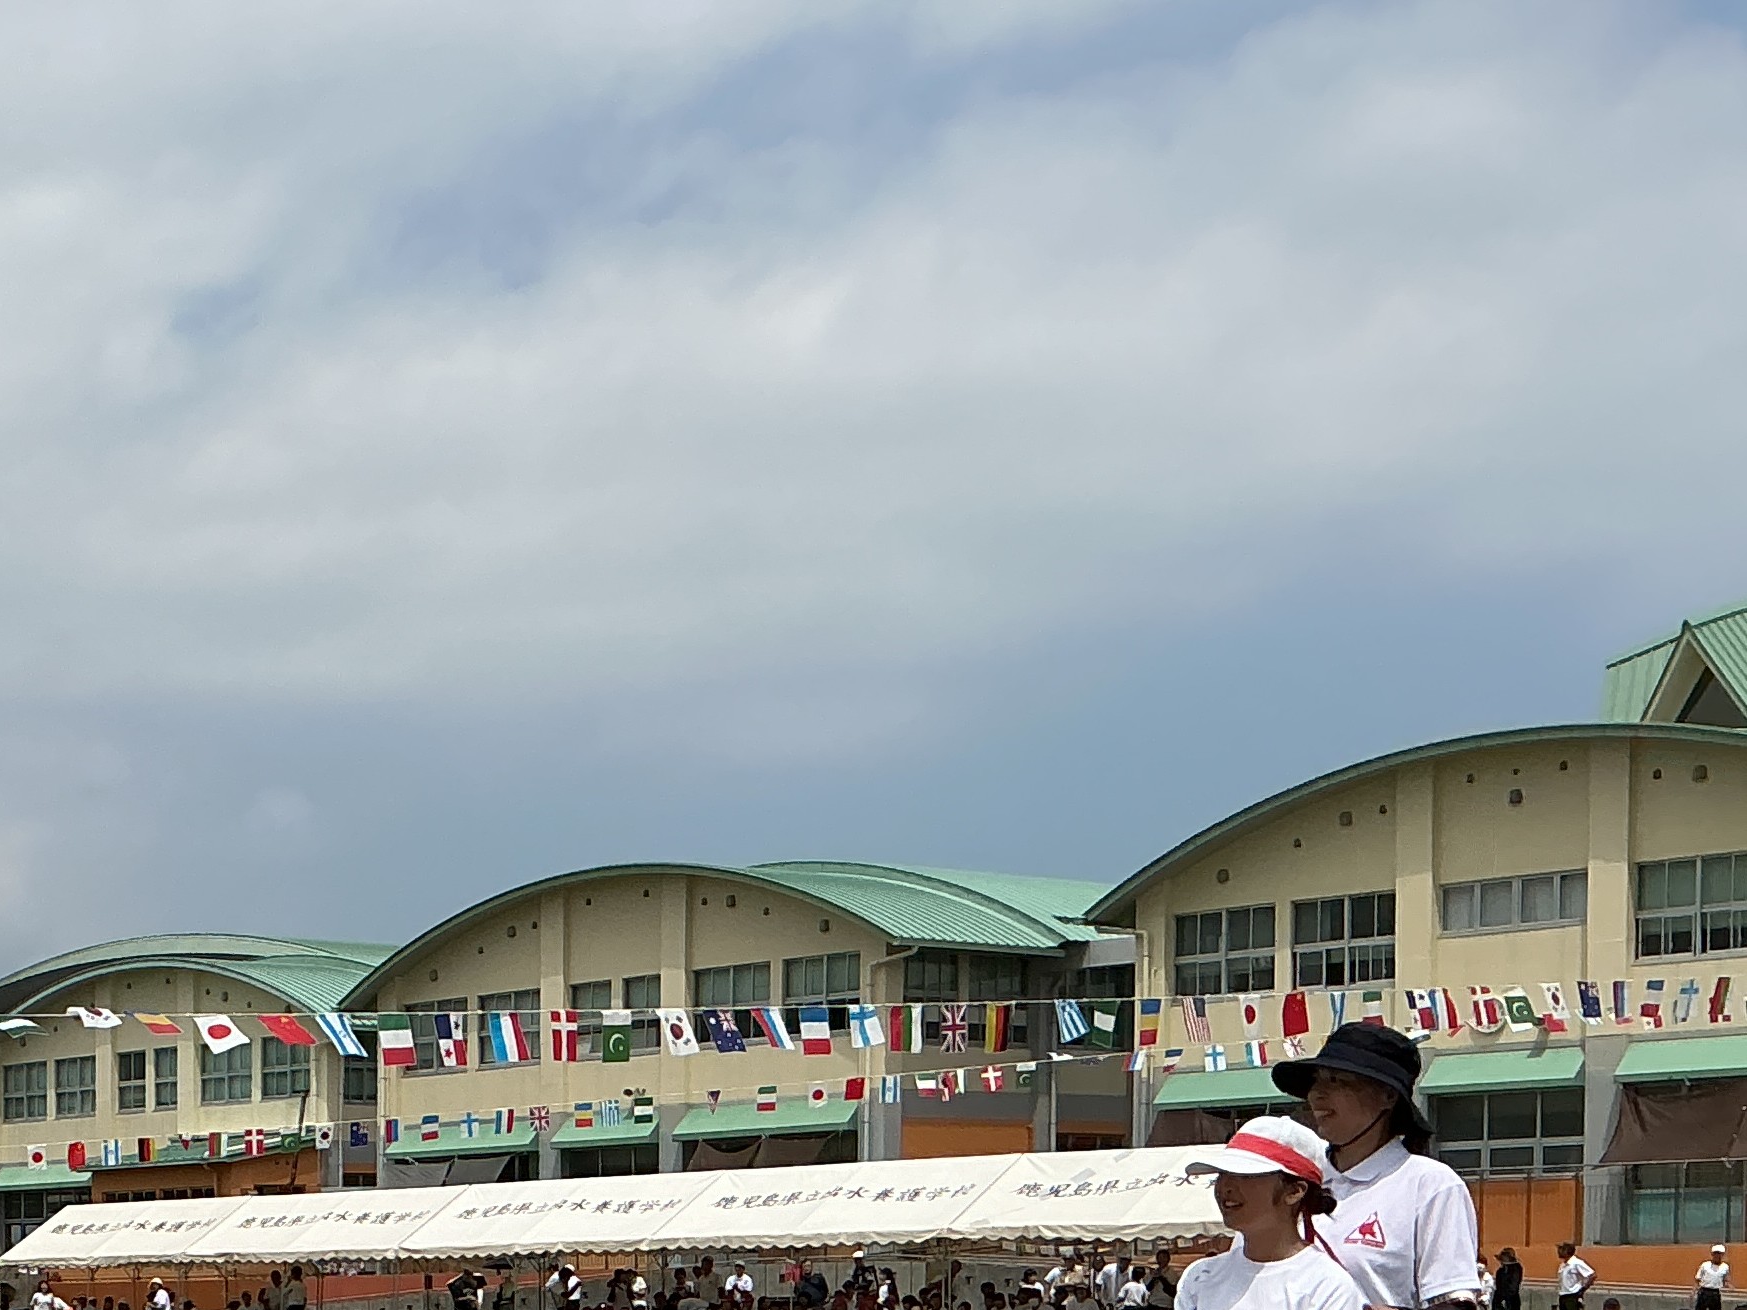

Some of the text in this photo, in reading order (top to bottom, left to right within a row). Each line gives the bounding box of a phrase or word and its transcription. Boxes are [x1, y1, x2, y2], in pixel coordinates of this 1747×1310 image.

[1010, 1172, 1218, 1198] 鹿児島県立出水
